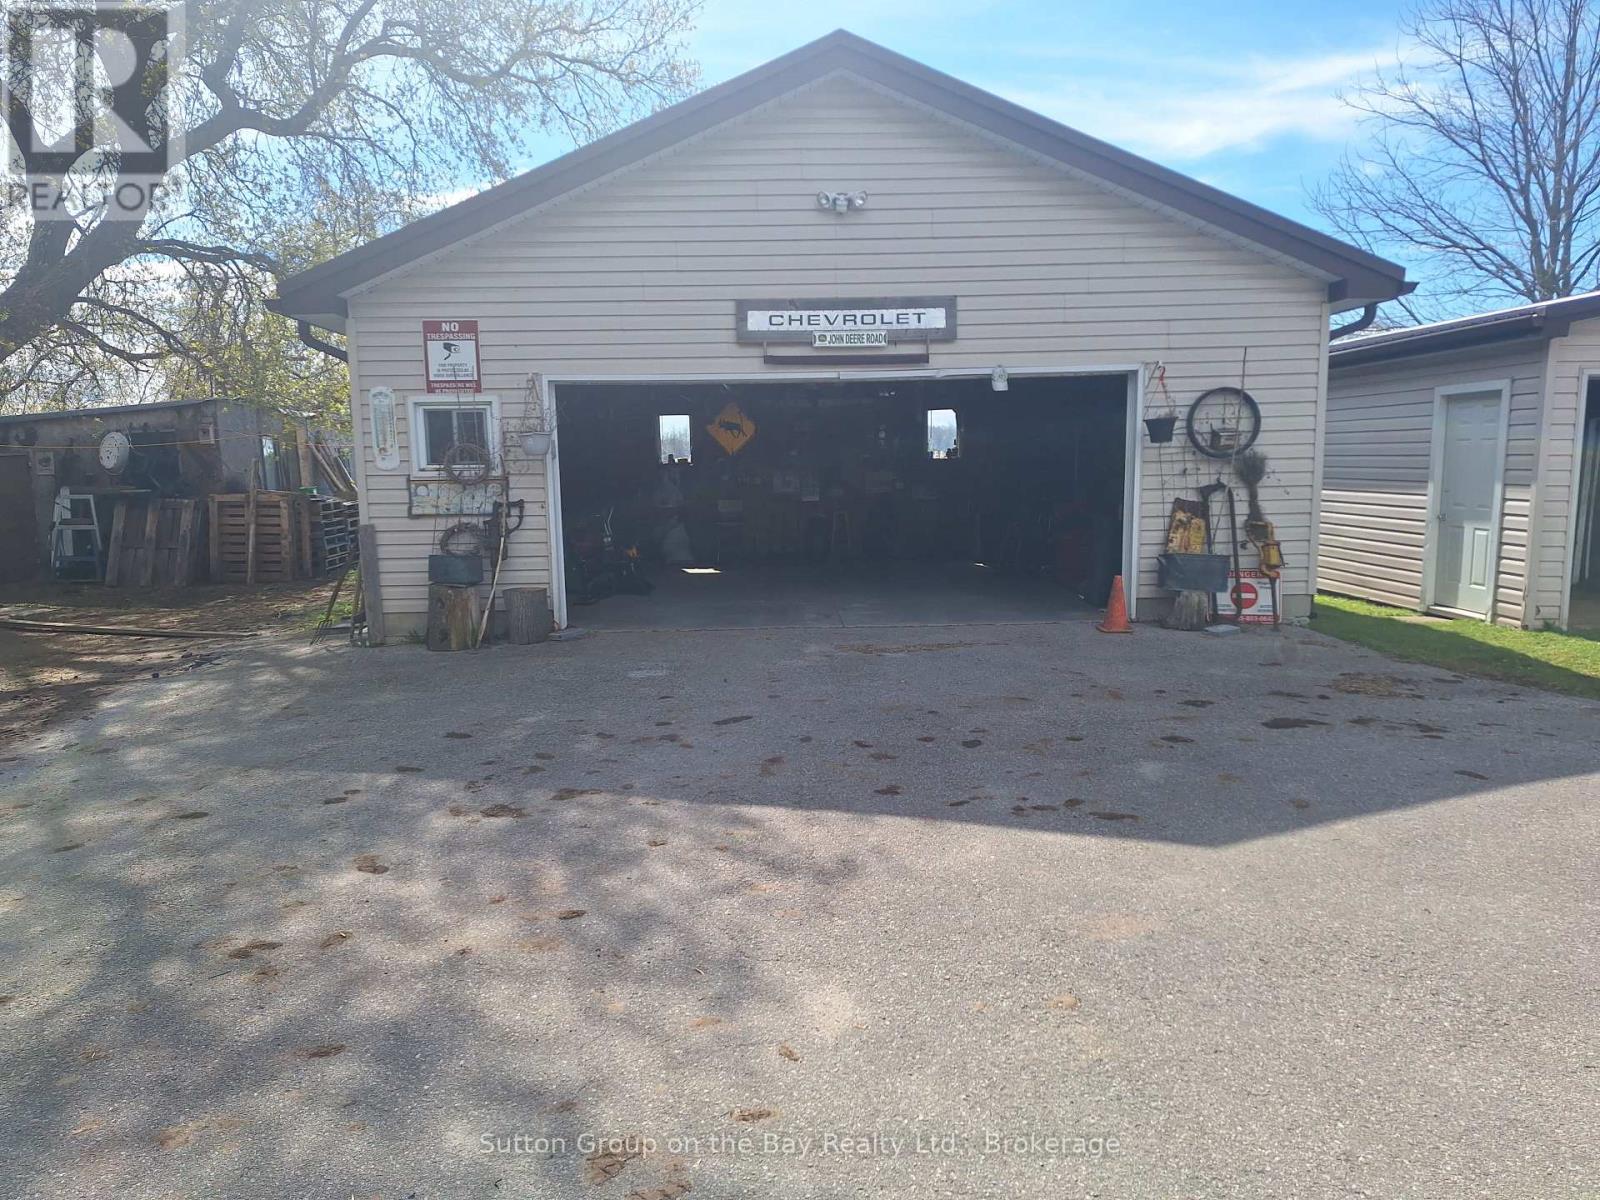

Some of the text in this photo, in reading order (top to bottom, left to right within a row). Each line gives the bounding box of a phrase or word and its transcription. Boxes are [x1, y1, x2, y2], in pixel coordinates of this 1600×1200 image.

[768, 312, 927, 327] CHEVROLET
[441, 322, 460, 332] NO
[426, 332, 476, 340] TRESPASSING
[828, 333, 882, 345] JOHN DEERE ROAD
